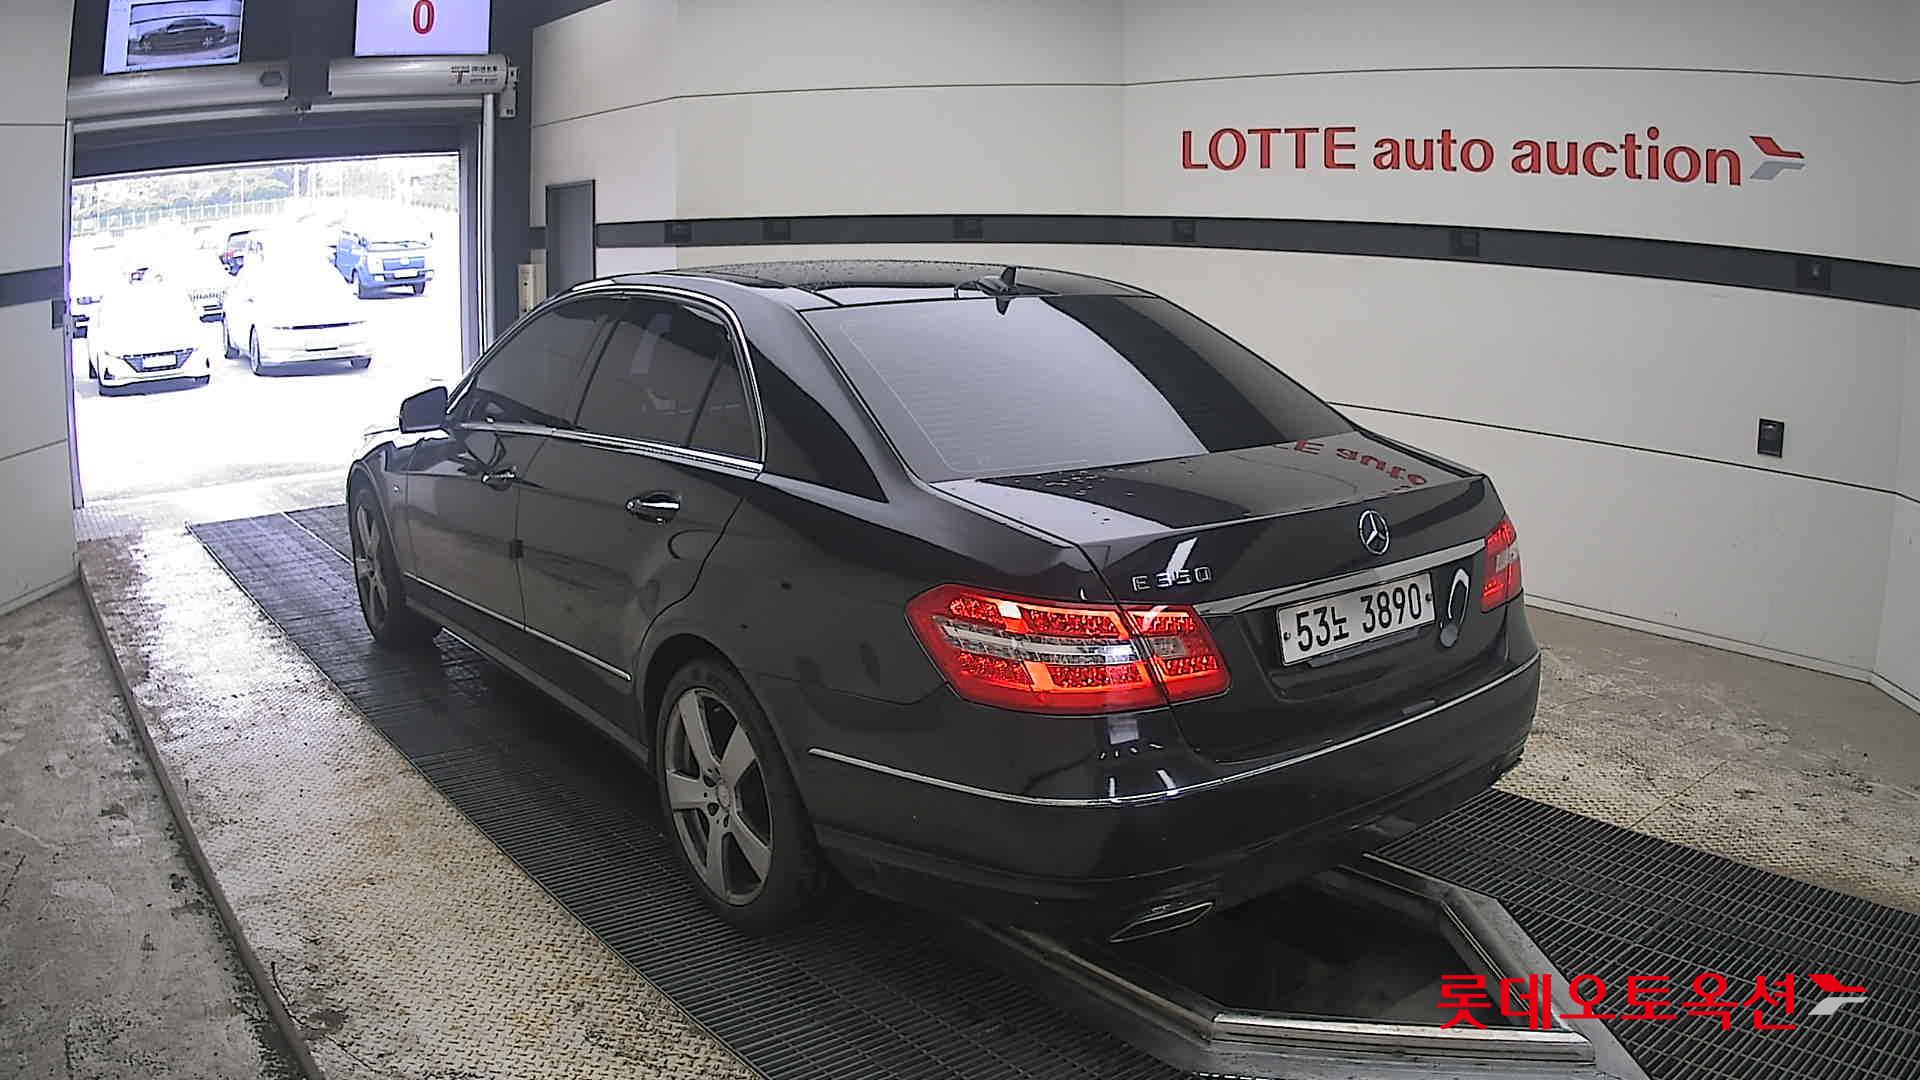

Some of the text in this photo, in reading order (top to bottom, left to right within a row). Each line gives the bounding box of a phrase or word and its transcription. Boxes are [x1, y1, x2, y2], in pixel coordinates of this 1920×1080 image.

[412, 0, 435, 34] 0
[1182, 126, 1742, 186] LOTTE auto auction
[1132, 566, 1212, 592] E 350
[1296, 583, 1422, 651] 53노 3890
